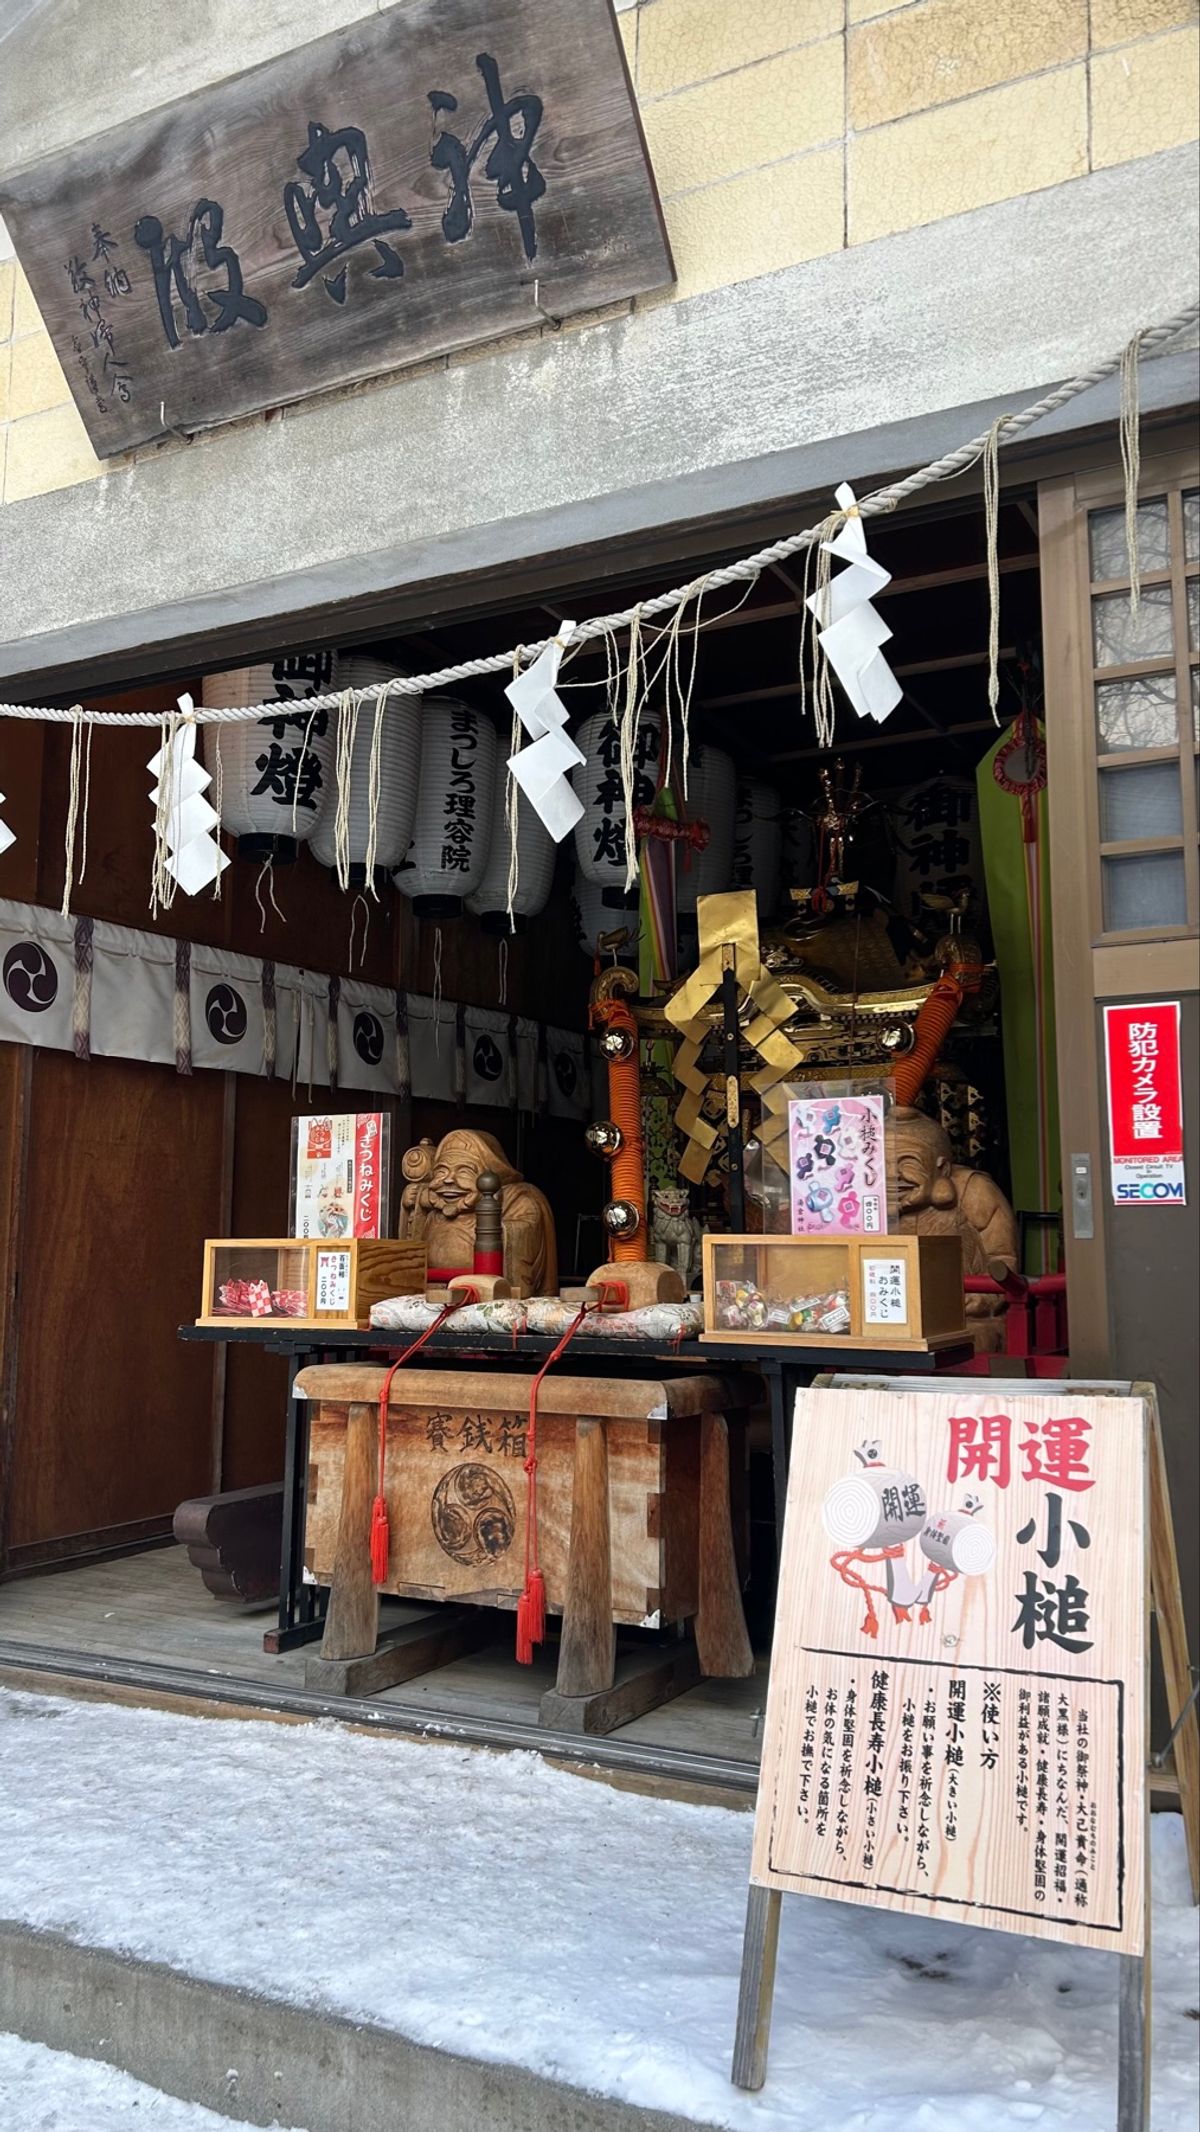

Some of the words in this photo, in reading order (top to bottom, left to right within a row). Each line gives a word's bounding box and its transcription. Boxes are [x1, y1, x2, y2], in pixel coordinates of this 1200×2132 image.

[441, 710, 479, 873] まつしろ理容院
[1128, 1022, 1163, 1139] 防犯カメラ設置
[359, 1134, 373, 1222] きつねみくじ
[1117, 1183, 1183, 1198] SECOM
[879, 1276, 889, 1318] おみくじ
[426, 1411, 529, 1458] 賽銭箱
[946, 1414, 1096, 1492] 開運
[882, 1483, 926, 1522] 開運
[1011, 1492, 1095, 1654] 小槌
[797, 1684, 819, 1825] 小槌でお撫で下さい。
[815, 1687, 838, 1837] お体の気になる箇所を
[896, 1697, 916, 1843] 小槌をお振り下さい。
[980, 1681, 1001, 1770] ※使い方
[1016, 1688, 1031, 1832] 御利益がある小槌です。
